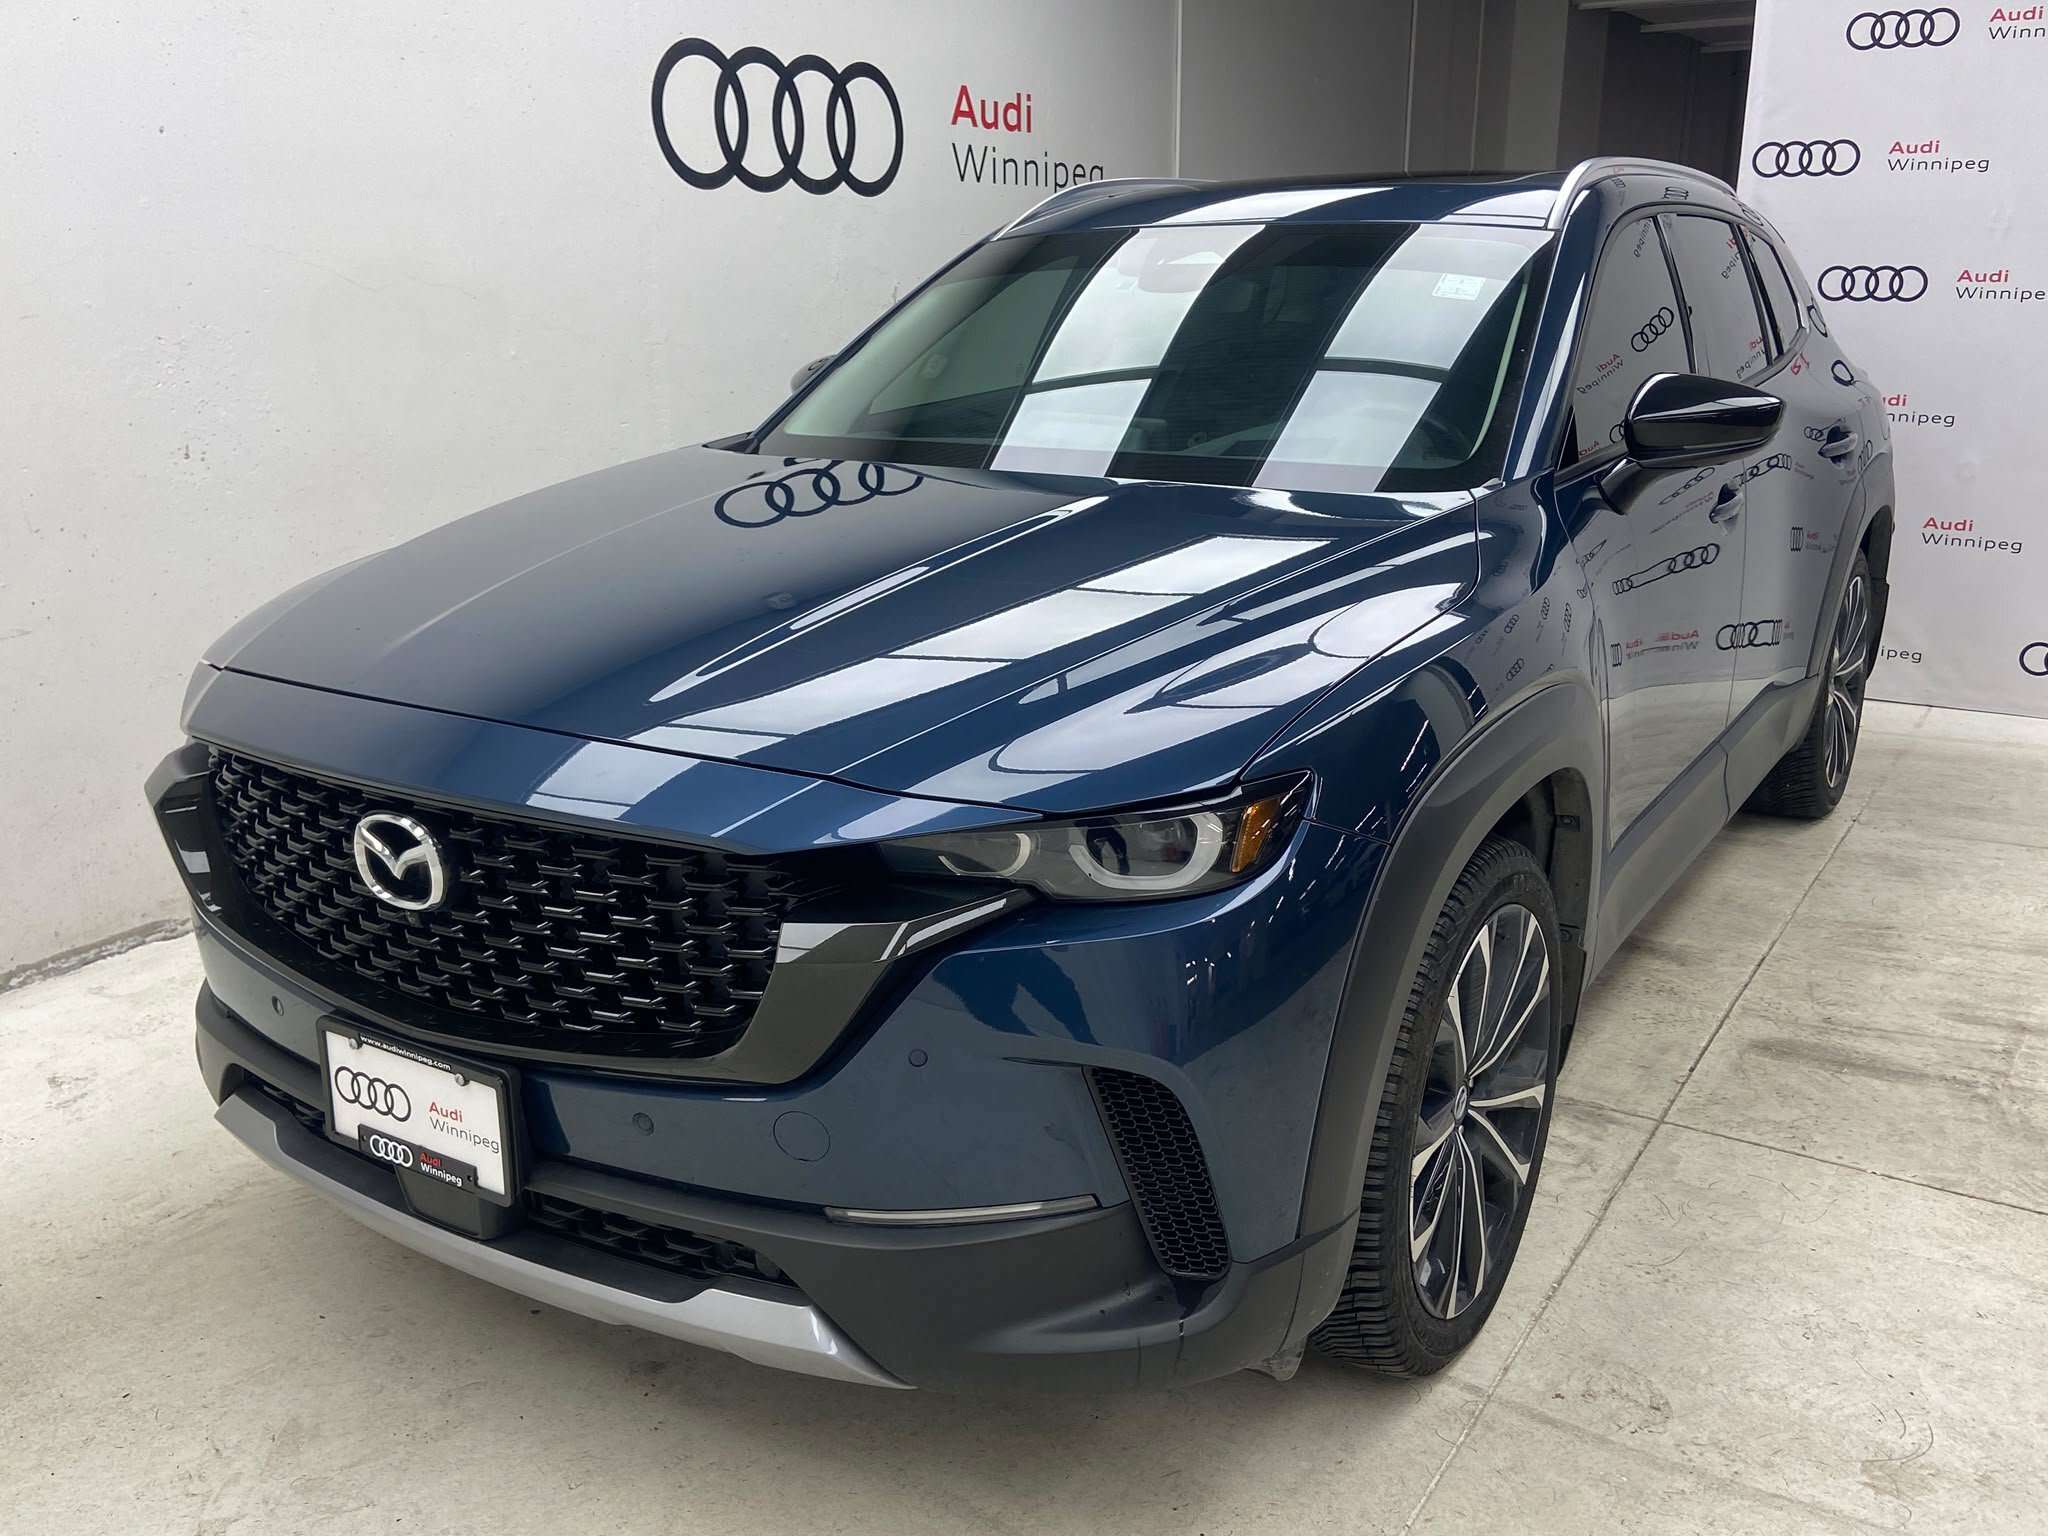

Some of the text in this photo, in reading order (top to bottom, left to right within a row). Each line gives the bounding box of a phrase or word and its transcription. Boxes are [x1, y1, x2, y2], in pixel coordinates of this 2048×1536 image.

[1990, 6, 2044, 22] Audi
[1989, 25, 2046, 39] Winn
[951, 84, 1032, 133] Audi
[1889, 140, 1940, 154] Audi
[1888, 157, 1990, 173] Winnipeg
[1957, 270, 2010, 283] Audi
[1956, 286, 2046, 303] Winnipe
[1882, 394, 1908, 407] di
[1886, 411, 1955, 428] nnipeg
[1923, 517, 1974, 532] Audi
[1921, 532, 2023, 554] Winnipeg
[1880, 645, 1922, 664] ipeg
[361, 1036, 451, 1071] www.audiwinnipeg.com
[429, 1101, 463, 1123] Audi
[429, 1116, 500, 1154] Winnipeg
[420, 1151, 442, 1167] Audi
[420, 1162, 462, 1187] Winnipeg
